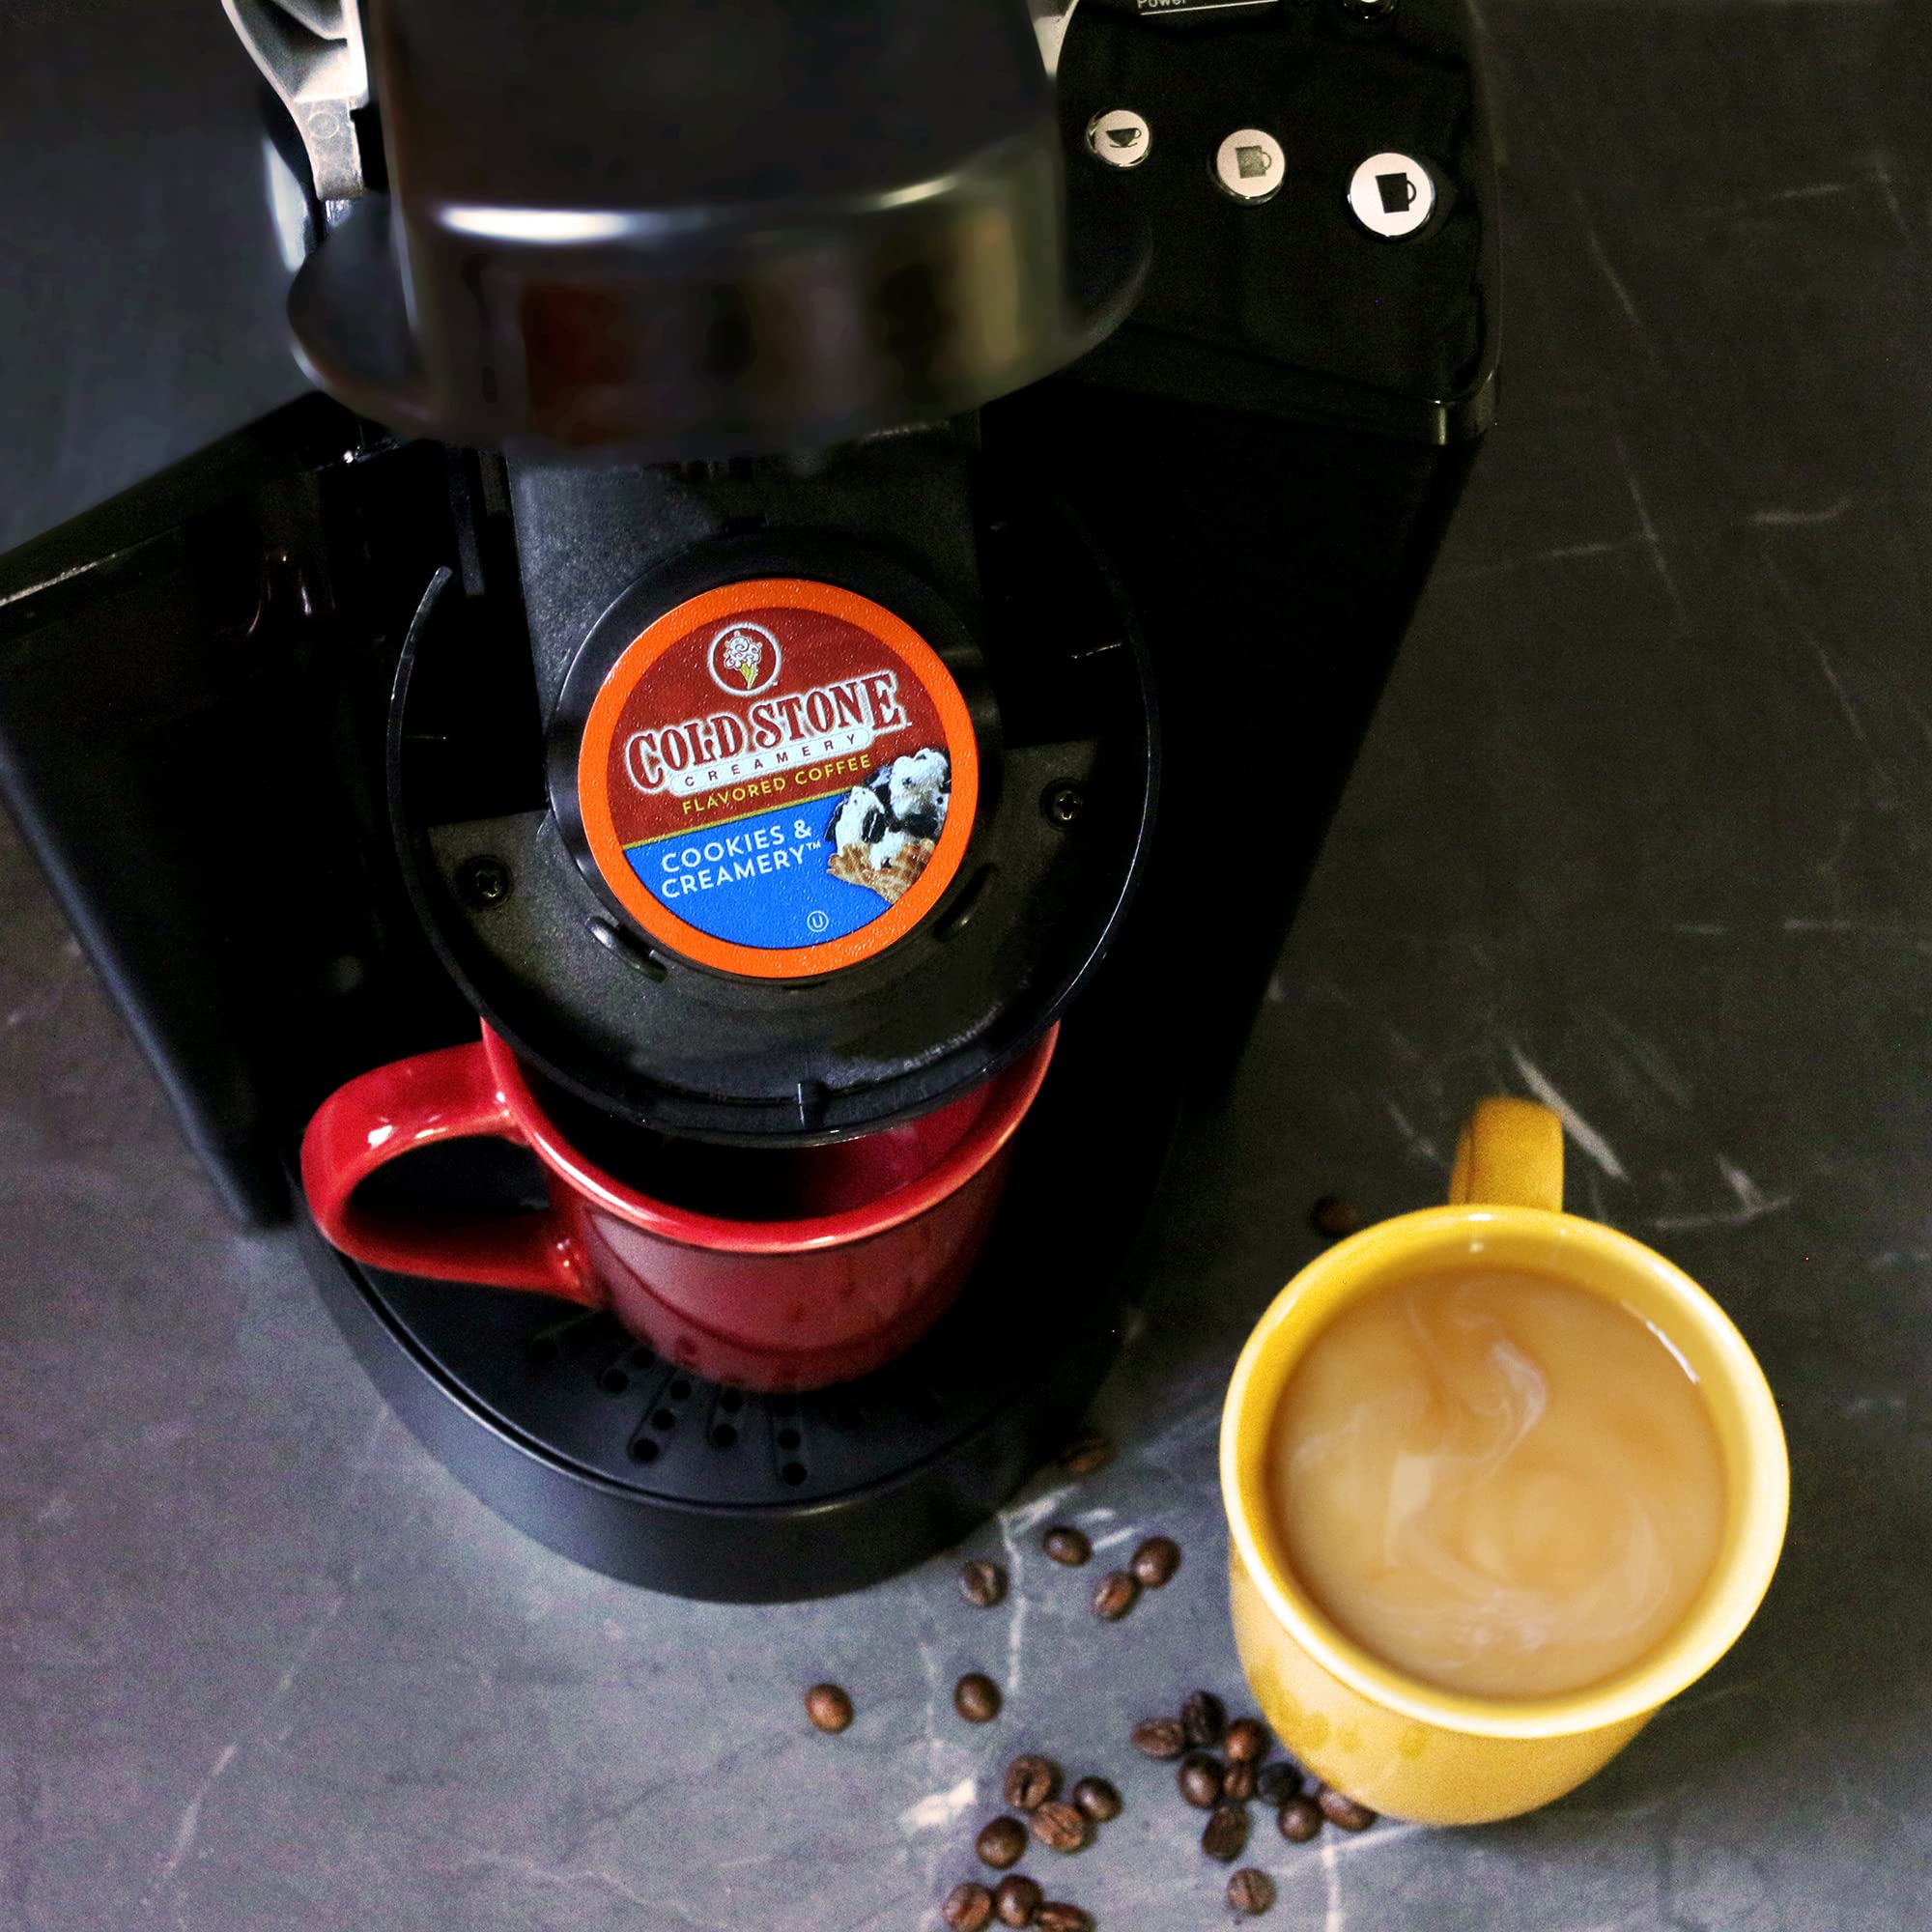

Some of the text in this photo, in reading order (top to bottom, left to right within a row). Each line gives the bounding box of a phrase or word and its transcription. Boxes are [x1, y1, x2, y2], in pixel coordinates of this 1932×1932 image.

[627, 672, 903, 791] COLD STONE
[685, 733, 857, 787] CREAMERY
[682, 753, 871, 815] FLAVORED COFFEE
[662, 819, 811, 872] COOKIES &
